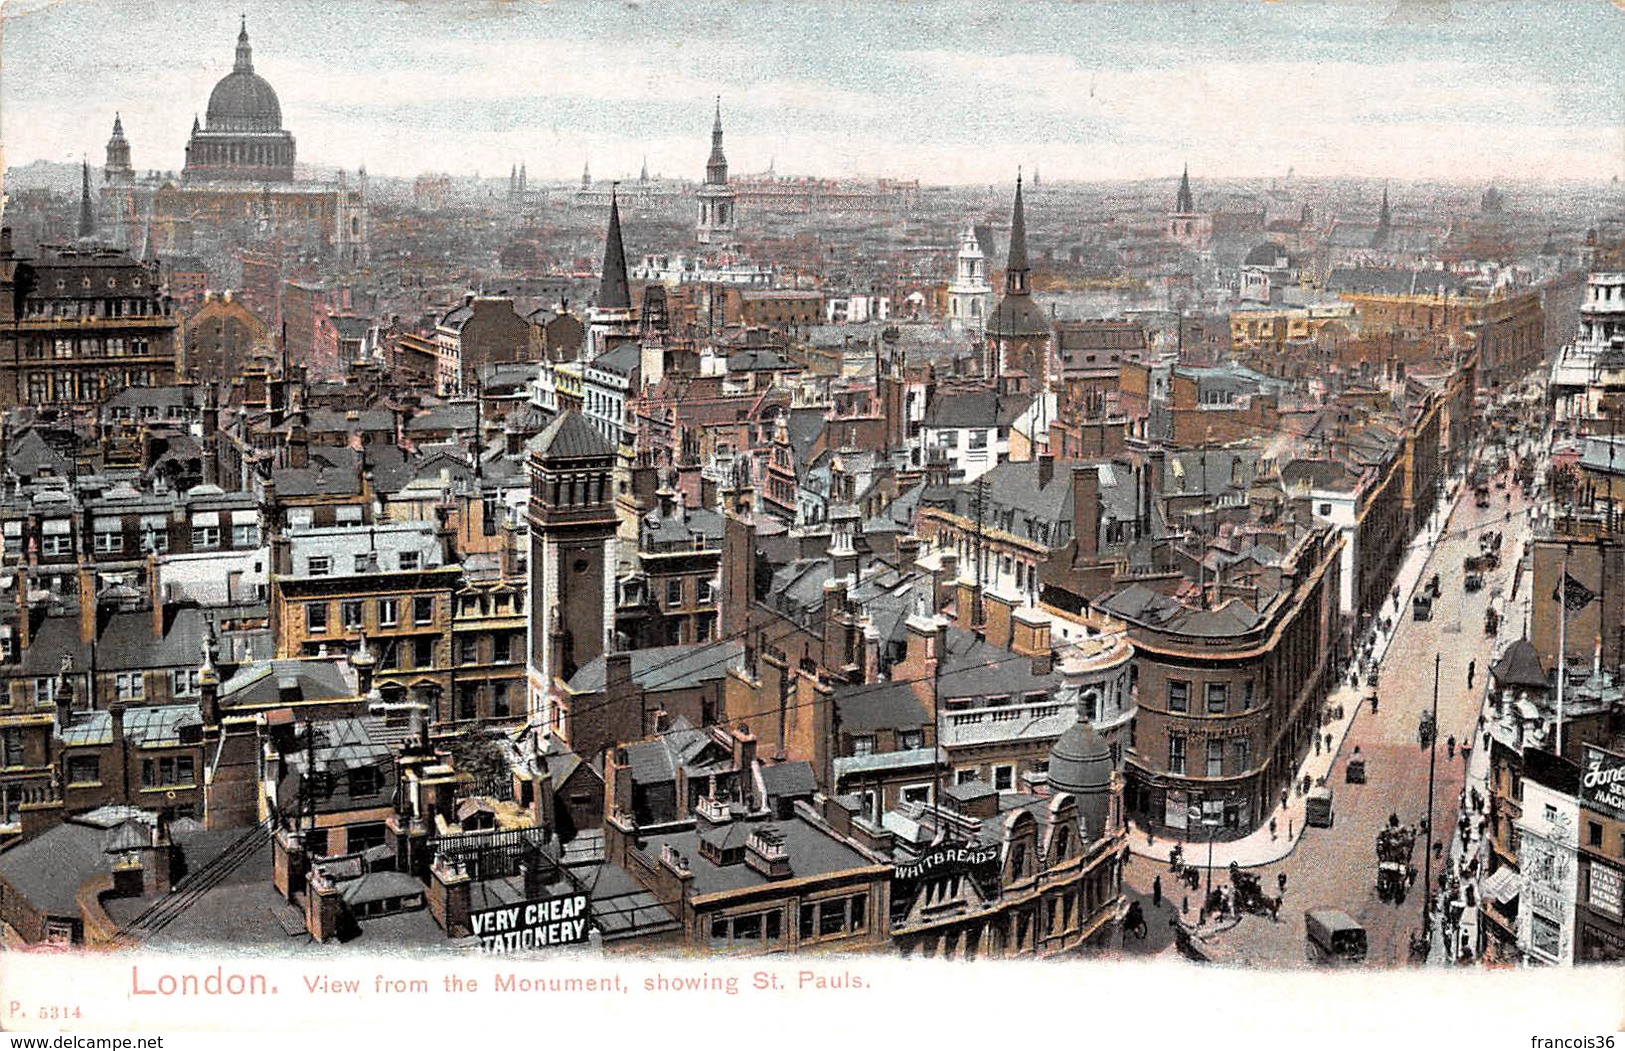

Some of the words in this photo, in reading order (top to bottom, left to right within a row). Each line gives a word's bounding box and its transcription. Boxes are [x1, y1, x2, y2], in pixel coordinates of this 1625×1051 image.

[470, 907, 520, 935] VERY
[525, 896, 587, 925] CHEAP
[476, 918, 586, 955] TATIONERY
